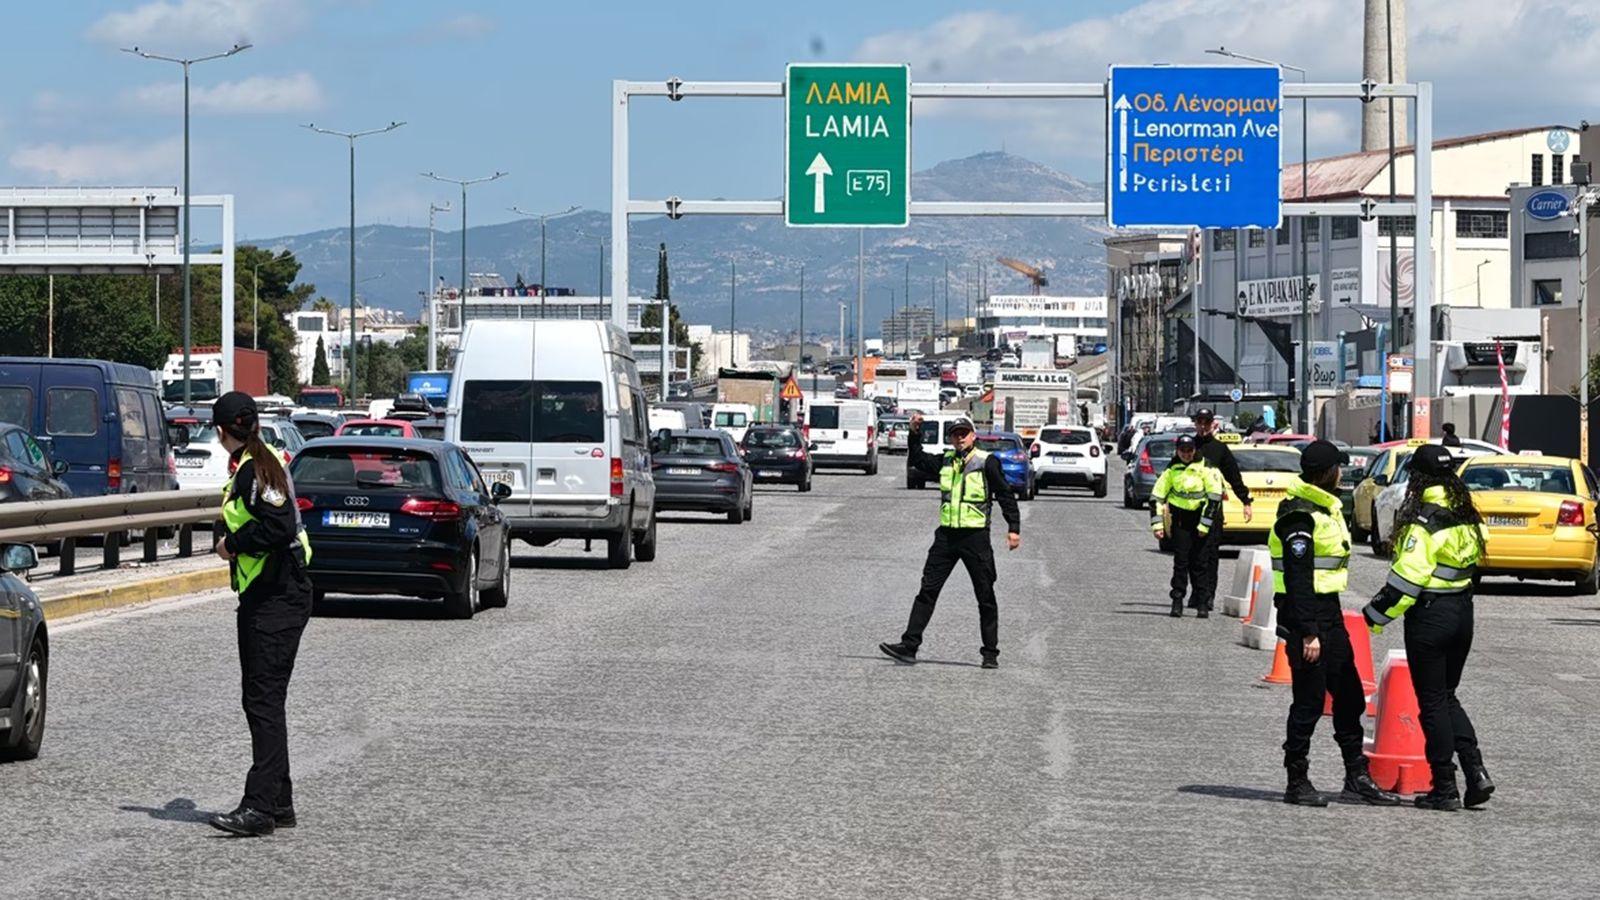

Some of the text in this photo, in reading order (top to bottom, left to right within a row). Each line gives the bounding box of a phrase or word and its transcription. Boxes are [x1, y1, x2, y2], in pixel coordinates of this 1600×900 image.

[805, 82, 891, 104] ΛΑΜΙΑ
[1133, 93, 1278, 117] Οδ. Λένορμαν
[805, 114, 889, 138] LAMIA
[1133, 118, 1279, 138] Lenorman Ave
[1133, 143, 1244, 166] Περιστέρι
[1531, 198, 1564, 211] Carrier
